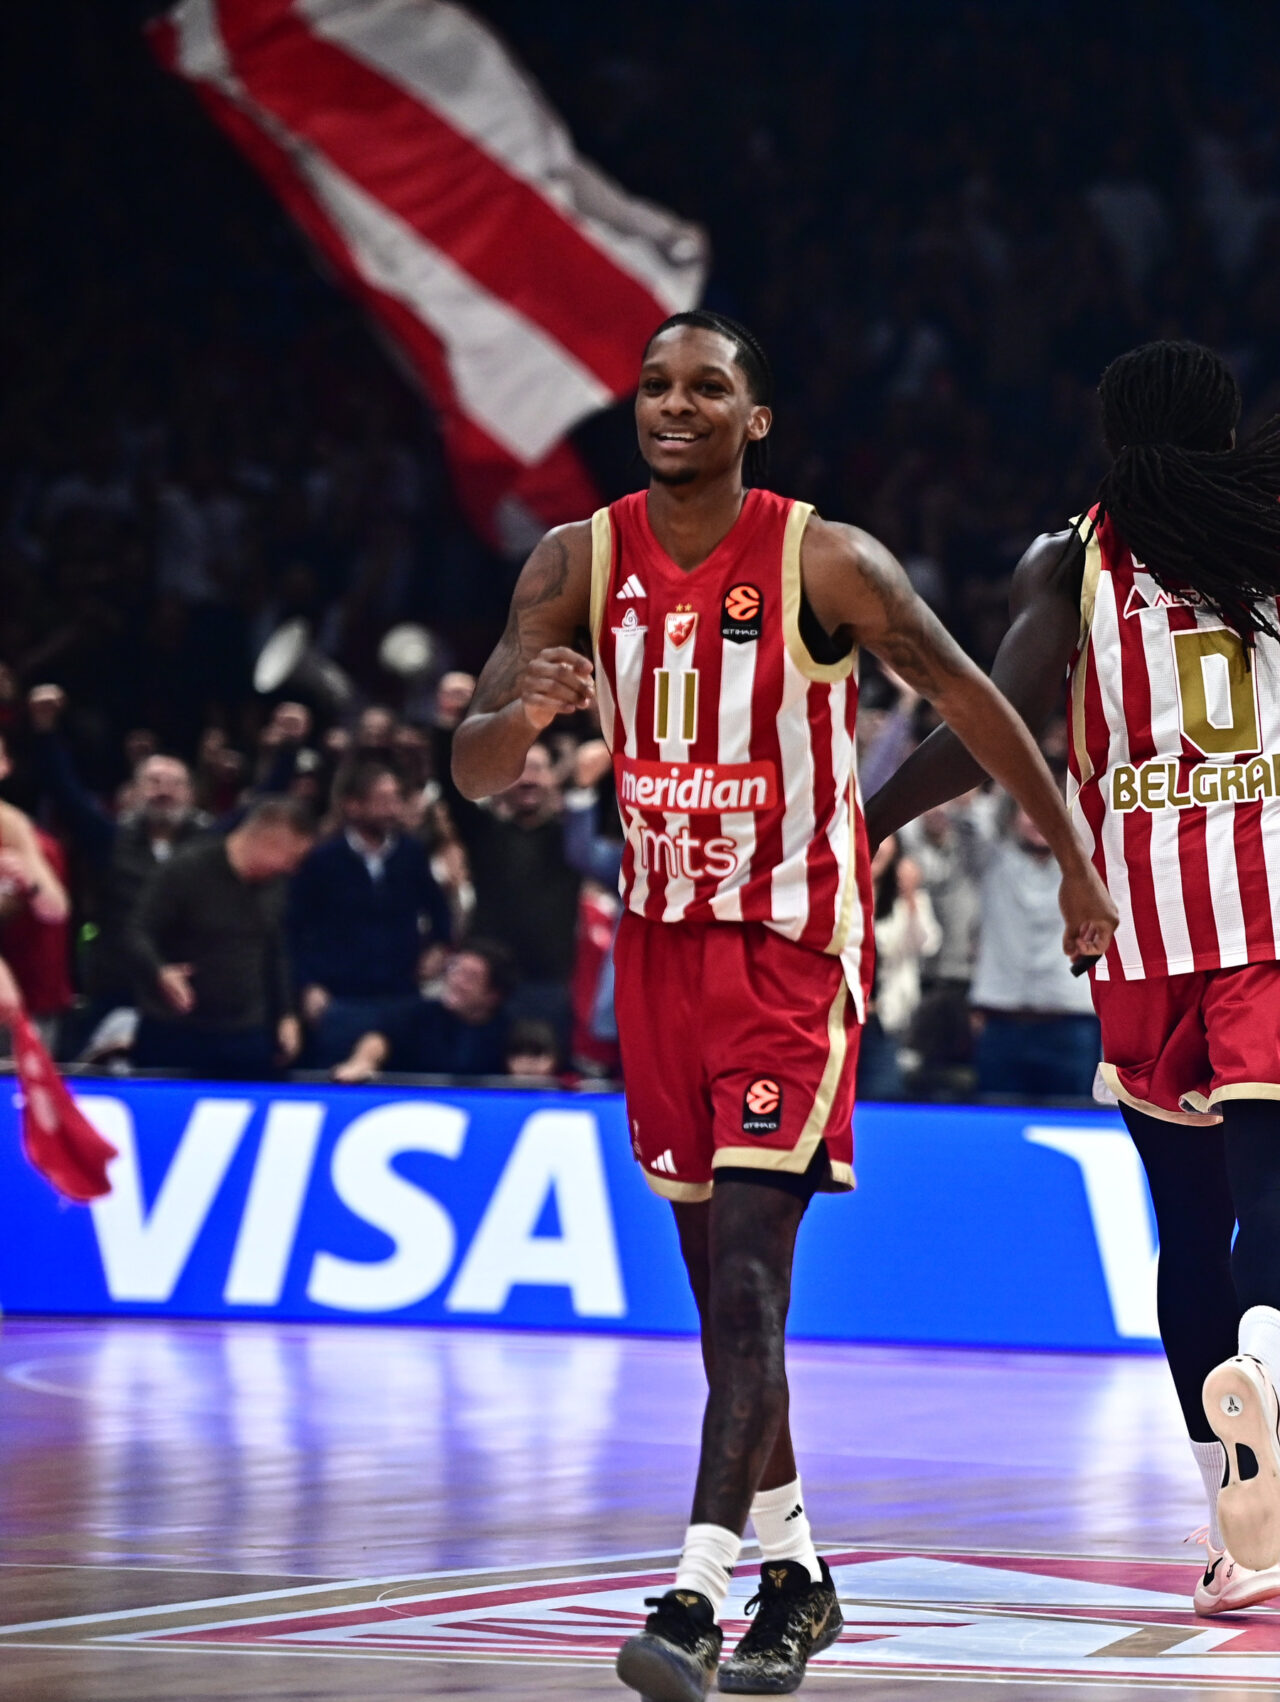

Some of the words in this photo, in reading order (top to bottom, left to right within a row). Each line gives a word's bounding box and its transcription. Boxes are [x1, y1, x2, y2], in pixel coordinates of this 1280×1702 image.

[722, 628, 758, 636] ETIHAD
[653, 667, 699, 744] 11
[1171, 627, 1262, 756] 0
[621, 767, 768, 809] meridian
[638, 826, 739, 880] mts
[16, 1096, 628, 1318] VISA
